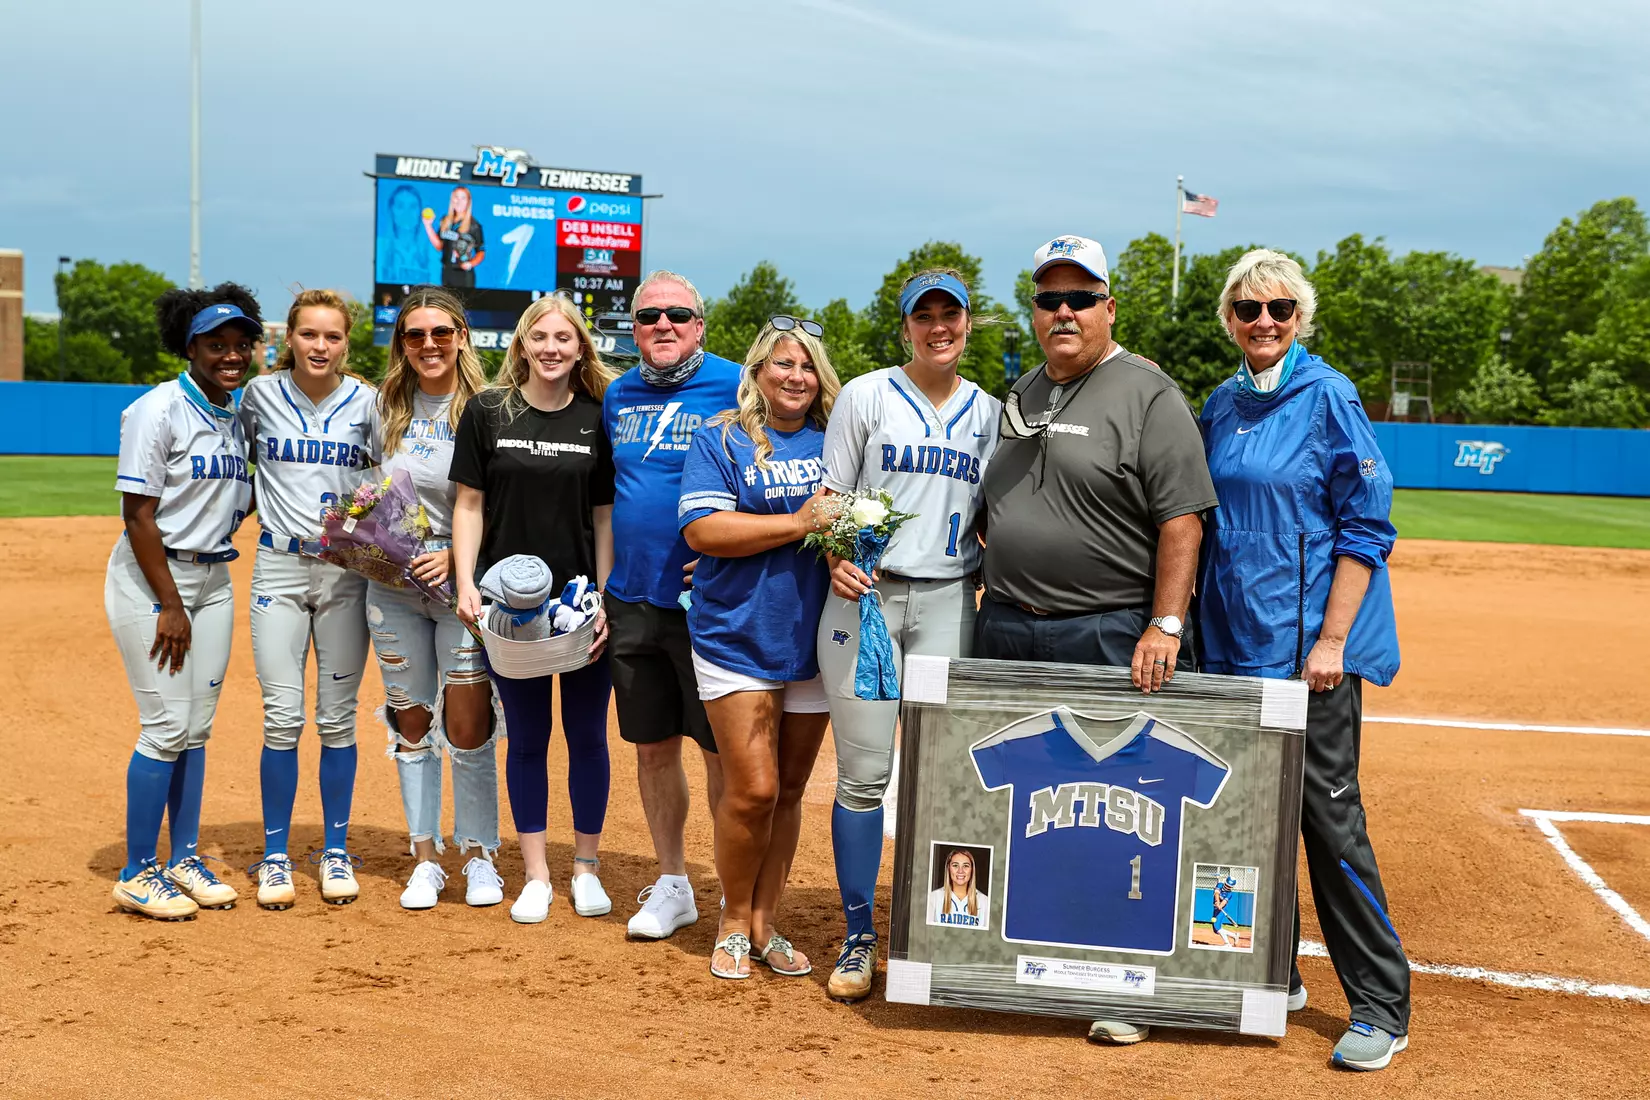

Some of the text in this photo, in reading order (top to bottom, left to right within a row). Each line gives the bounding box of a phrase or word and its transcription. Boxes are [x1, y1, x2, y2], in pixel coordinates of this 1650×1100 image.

[395, 157, 464, 180] MIDDLE
[539, 169, 632, 193] TENNESSEE
[510, 194, 555, 206] SUMMER
[589, 202, 631, 217] pepsi
[492, 204, 555, 220] BURGESS
[562, 221, 634, 237] DEB INSELL
[573, 277, 624, 291] 10:37 AM
[671, 412, 702, 444] UP
[266, 437, 360, 467] RAIDERS
[496, 438, 592, 455] MIDDLE TENNESSEE
[1453, 440, 1504, 475] MT
[881, 444, 980, 484] RAIDERS
[765, 486, 785, 500] OUR
[945, 512, 961, 557] 1
[1025, 782, 1165, 847] MTSU
[1127, 854, 1143, 900] 1
[940, 913, 980, 926] RAIDERS
